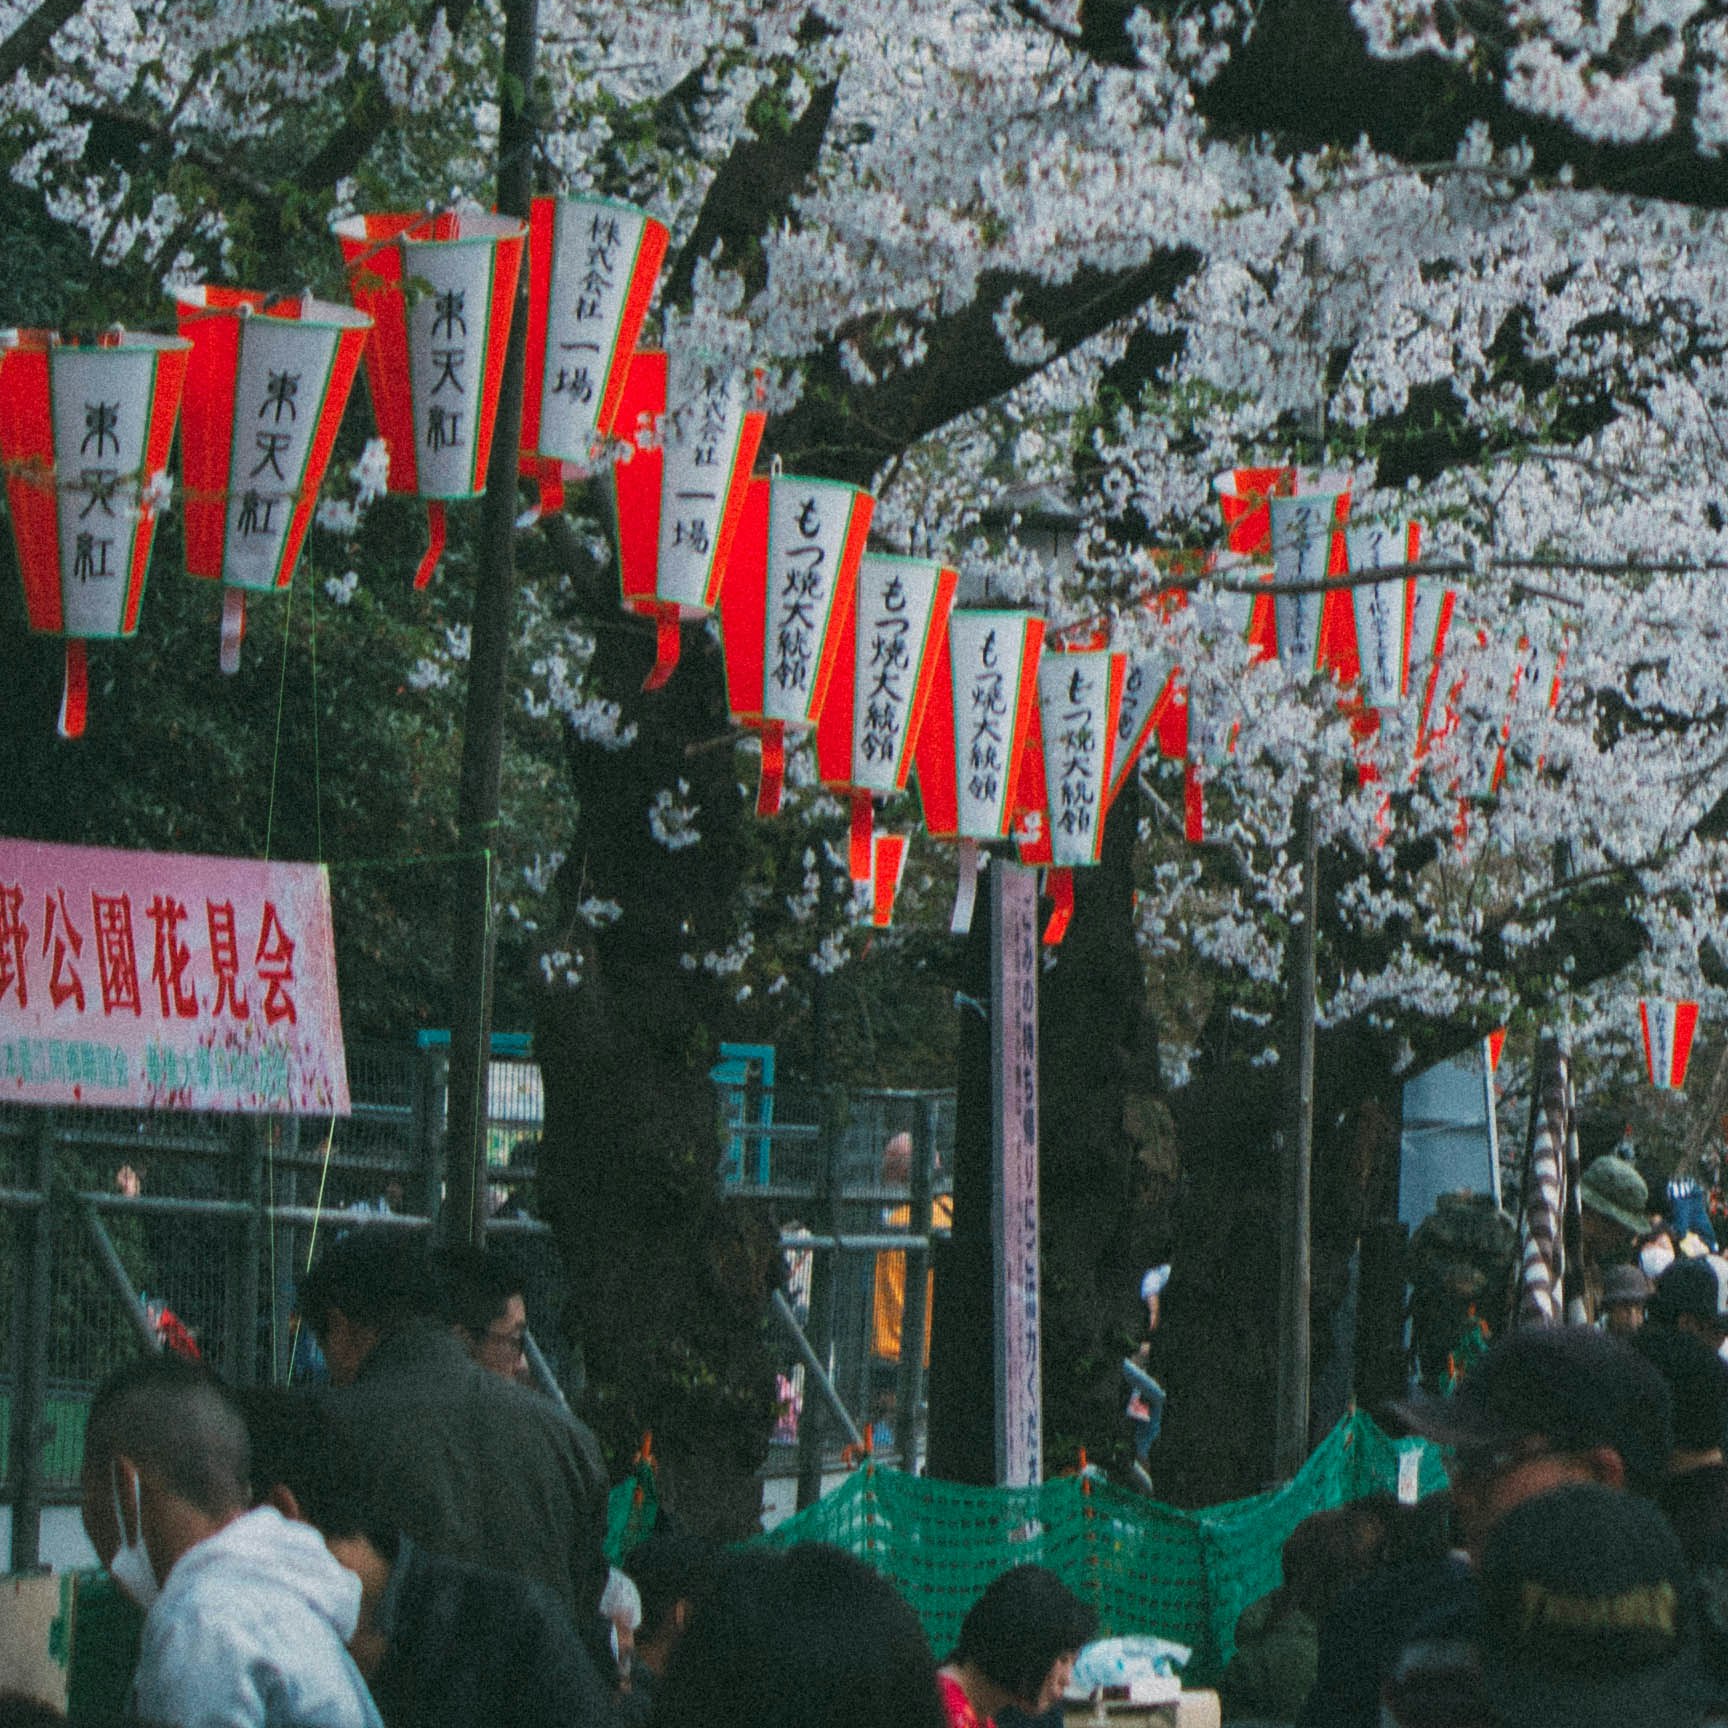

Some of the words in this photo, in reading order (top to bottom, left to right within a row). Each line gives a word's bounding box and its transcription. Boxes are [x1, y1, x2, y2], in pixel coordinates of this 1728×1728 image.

[237, 368, 303, 538] 東天紅
[427, 287, 467, 453] 東天紅
[73, 400, 121, 584] 東天紅
[771, 497, 826, 692] もつ焼大統領
[860, 575, 911, 762] もつ焼大統領
[968, 628, 1008, 804] もつ焼大統領
